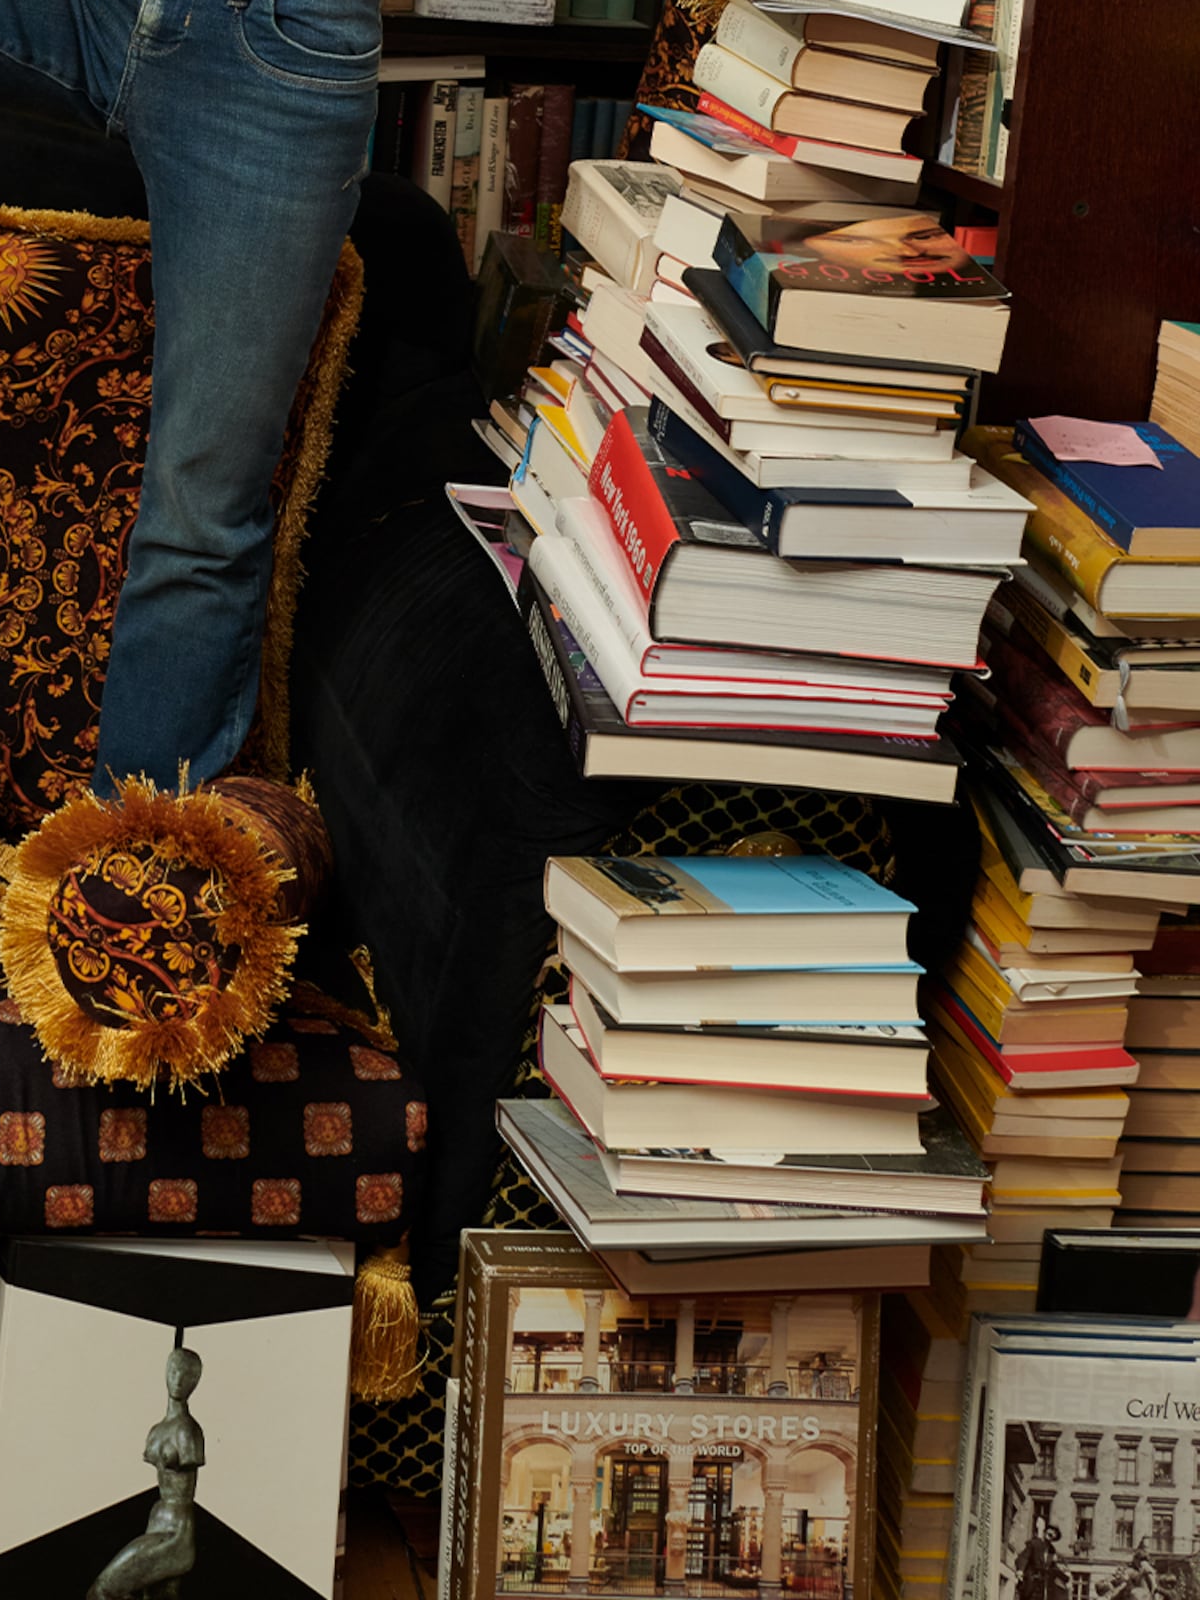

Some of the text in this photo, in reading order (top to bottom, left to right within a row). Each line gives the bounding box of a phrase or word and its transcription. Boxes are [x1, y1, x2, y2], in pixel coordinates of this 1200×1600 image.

[432, 119, 447, 178] FRANKENSTEIN
[778, 261, 985, 284] GOGOL
[600, 464, 647, 575] New York 1960
[462, 1286, 479, 1427] LUXURY
[541, 1410, 821, 1441] LUXURY STORES
[1126, 1392, 1171, 1420] Carl
[624, 1442, 742, 1458] TOP OF THE WORLD
[454, 1431, 470, 1568] STORES
